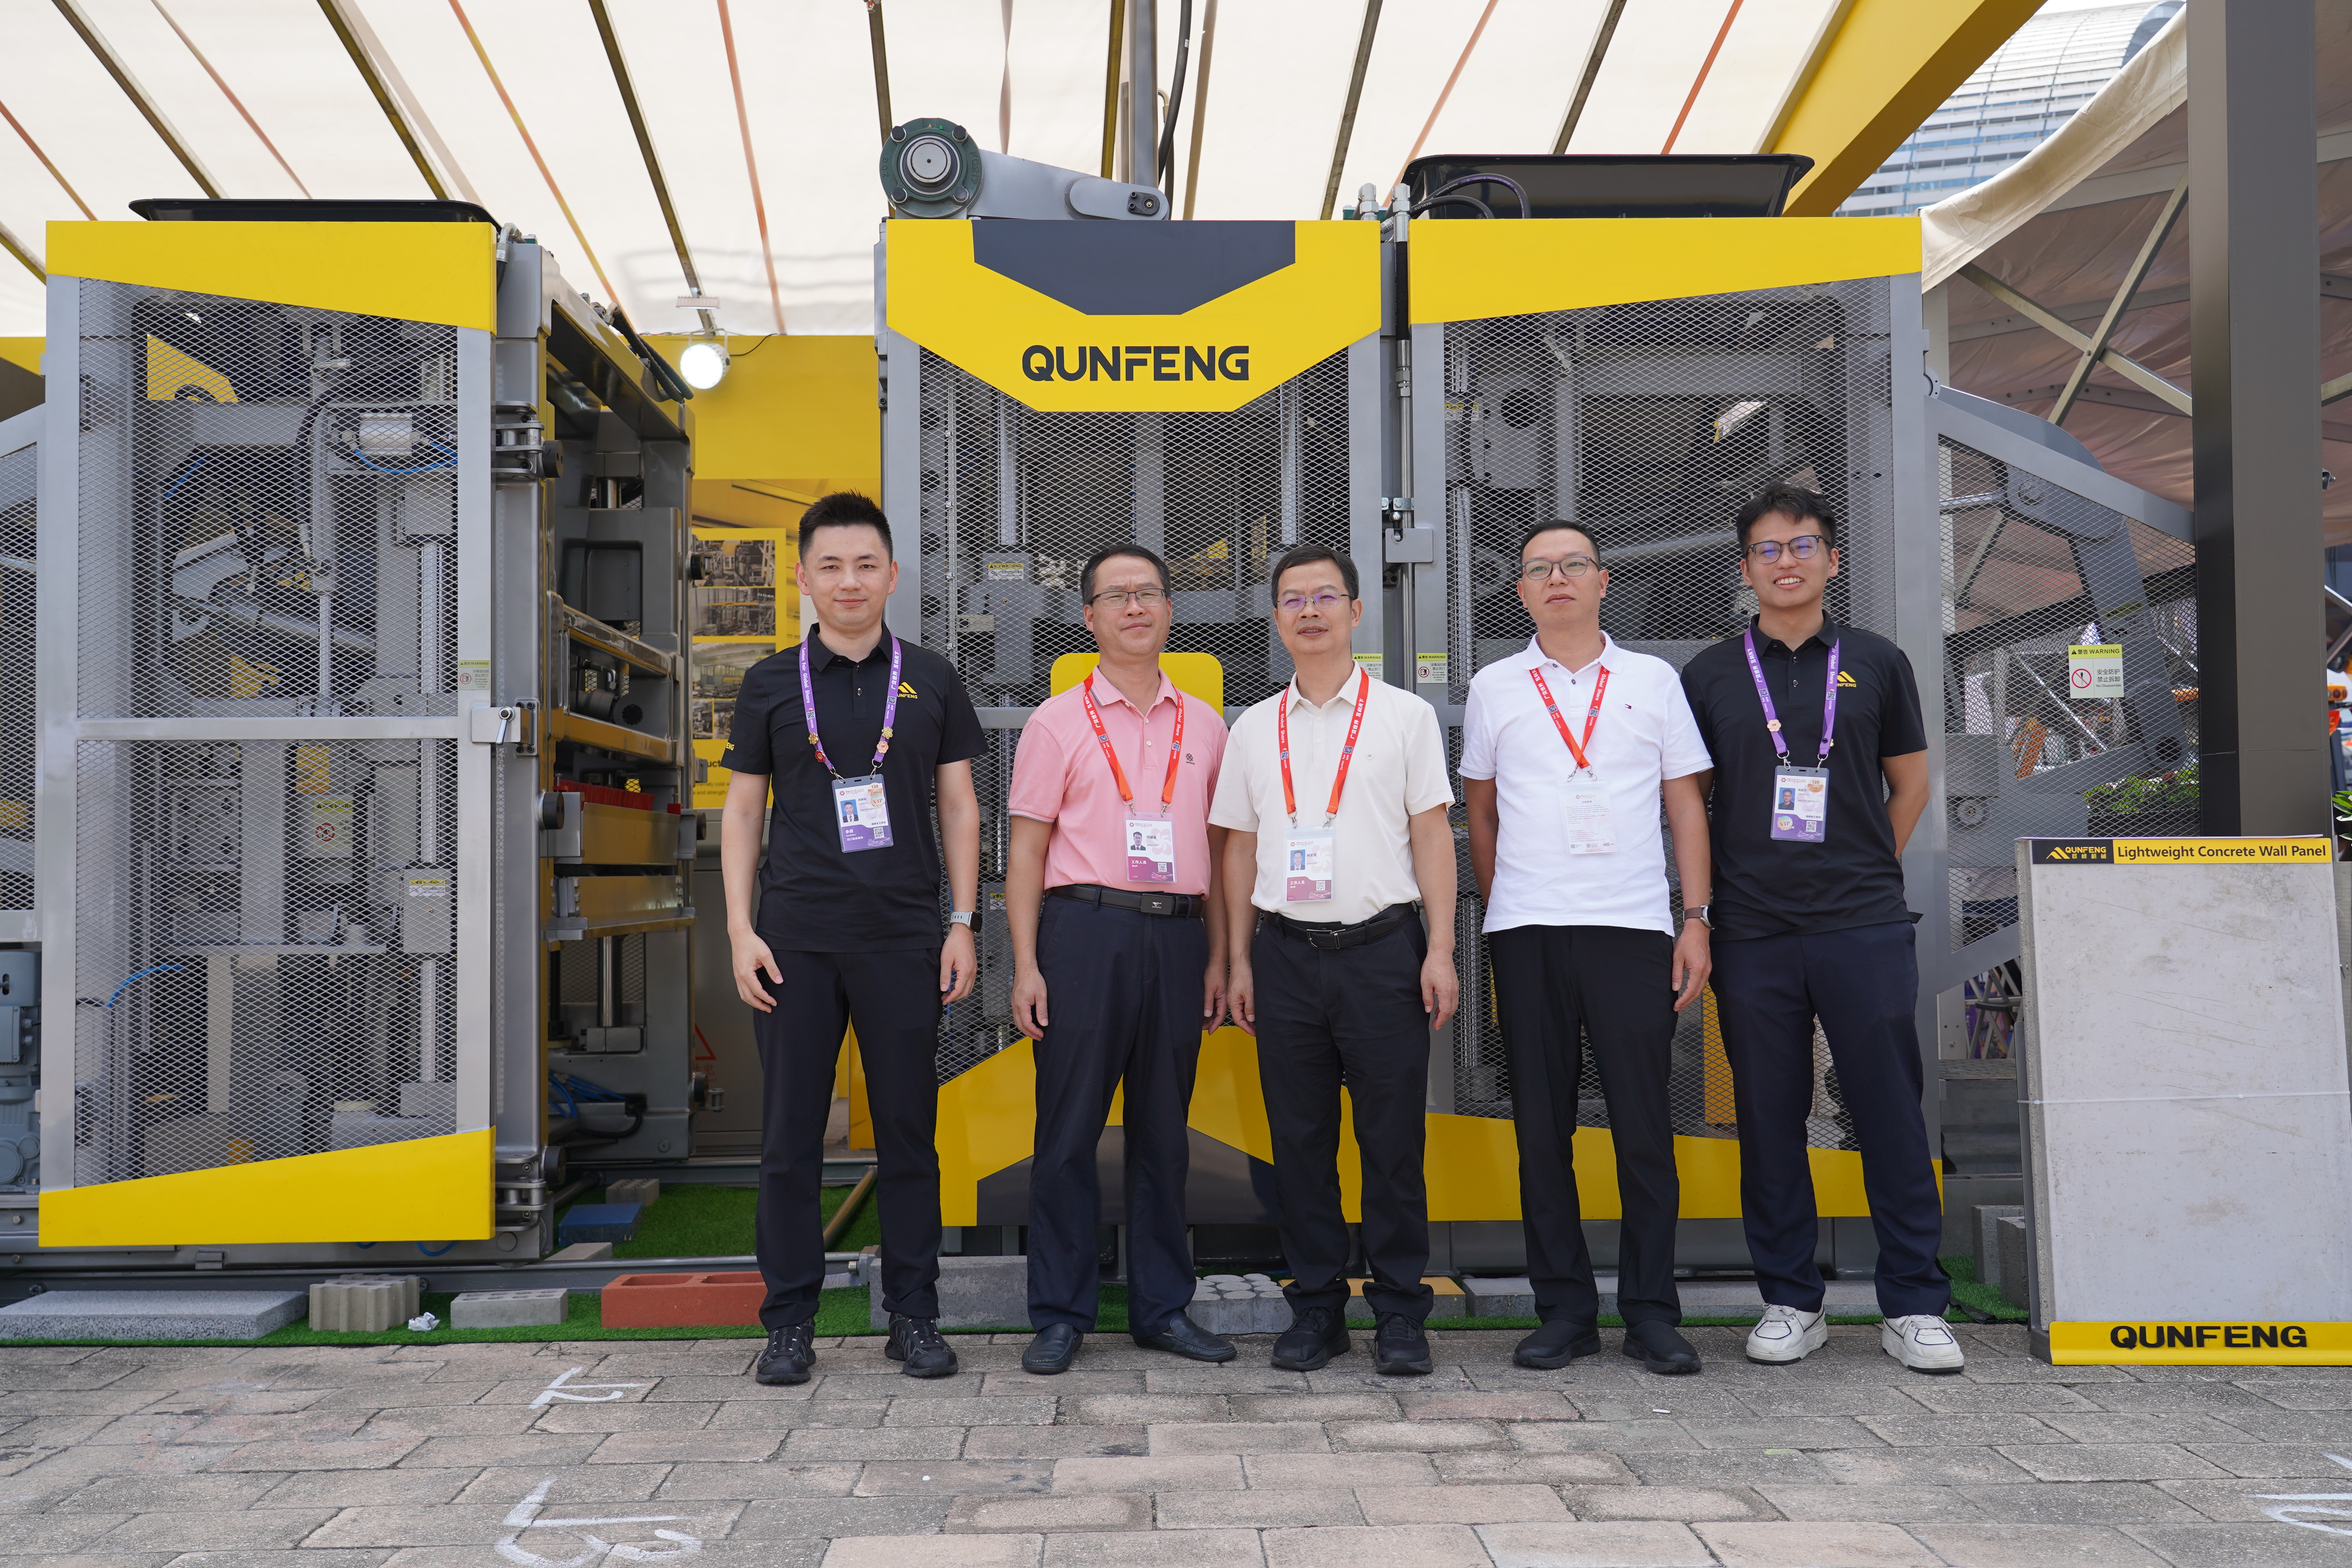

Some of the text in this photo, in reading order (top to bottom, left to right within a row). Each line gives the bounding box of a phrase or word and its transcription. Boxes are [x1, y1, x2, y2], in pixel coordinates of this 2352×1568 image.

[969, 152, 980, 184] FC217
[1022, 345, 1249, 381] QUNFENG
[1532, 669, 1541, 682] 互利天
[1350, 720, 1359, 739] 广交世界
[726, 742, 735, 750] ENG
[2118, 846, 2194, 860] Lightweight
[2198, 846, 2255, 857] Concrete
[2259, 846, 2287, 856] Wall
[2292, 845, 2325, 856] Panel
[2111, 1326, 2307, 1350] QUNFENG
